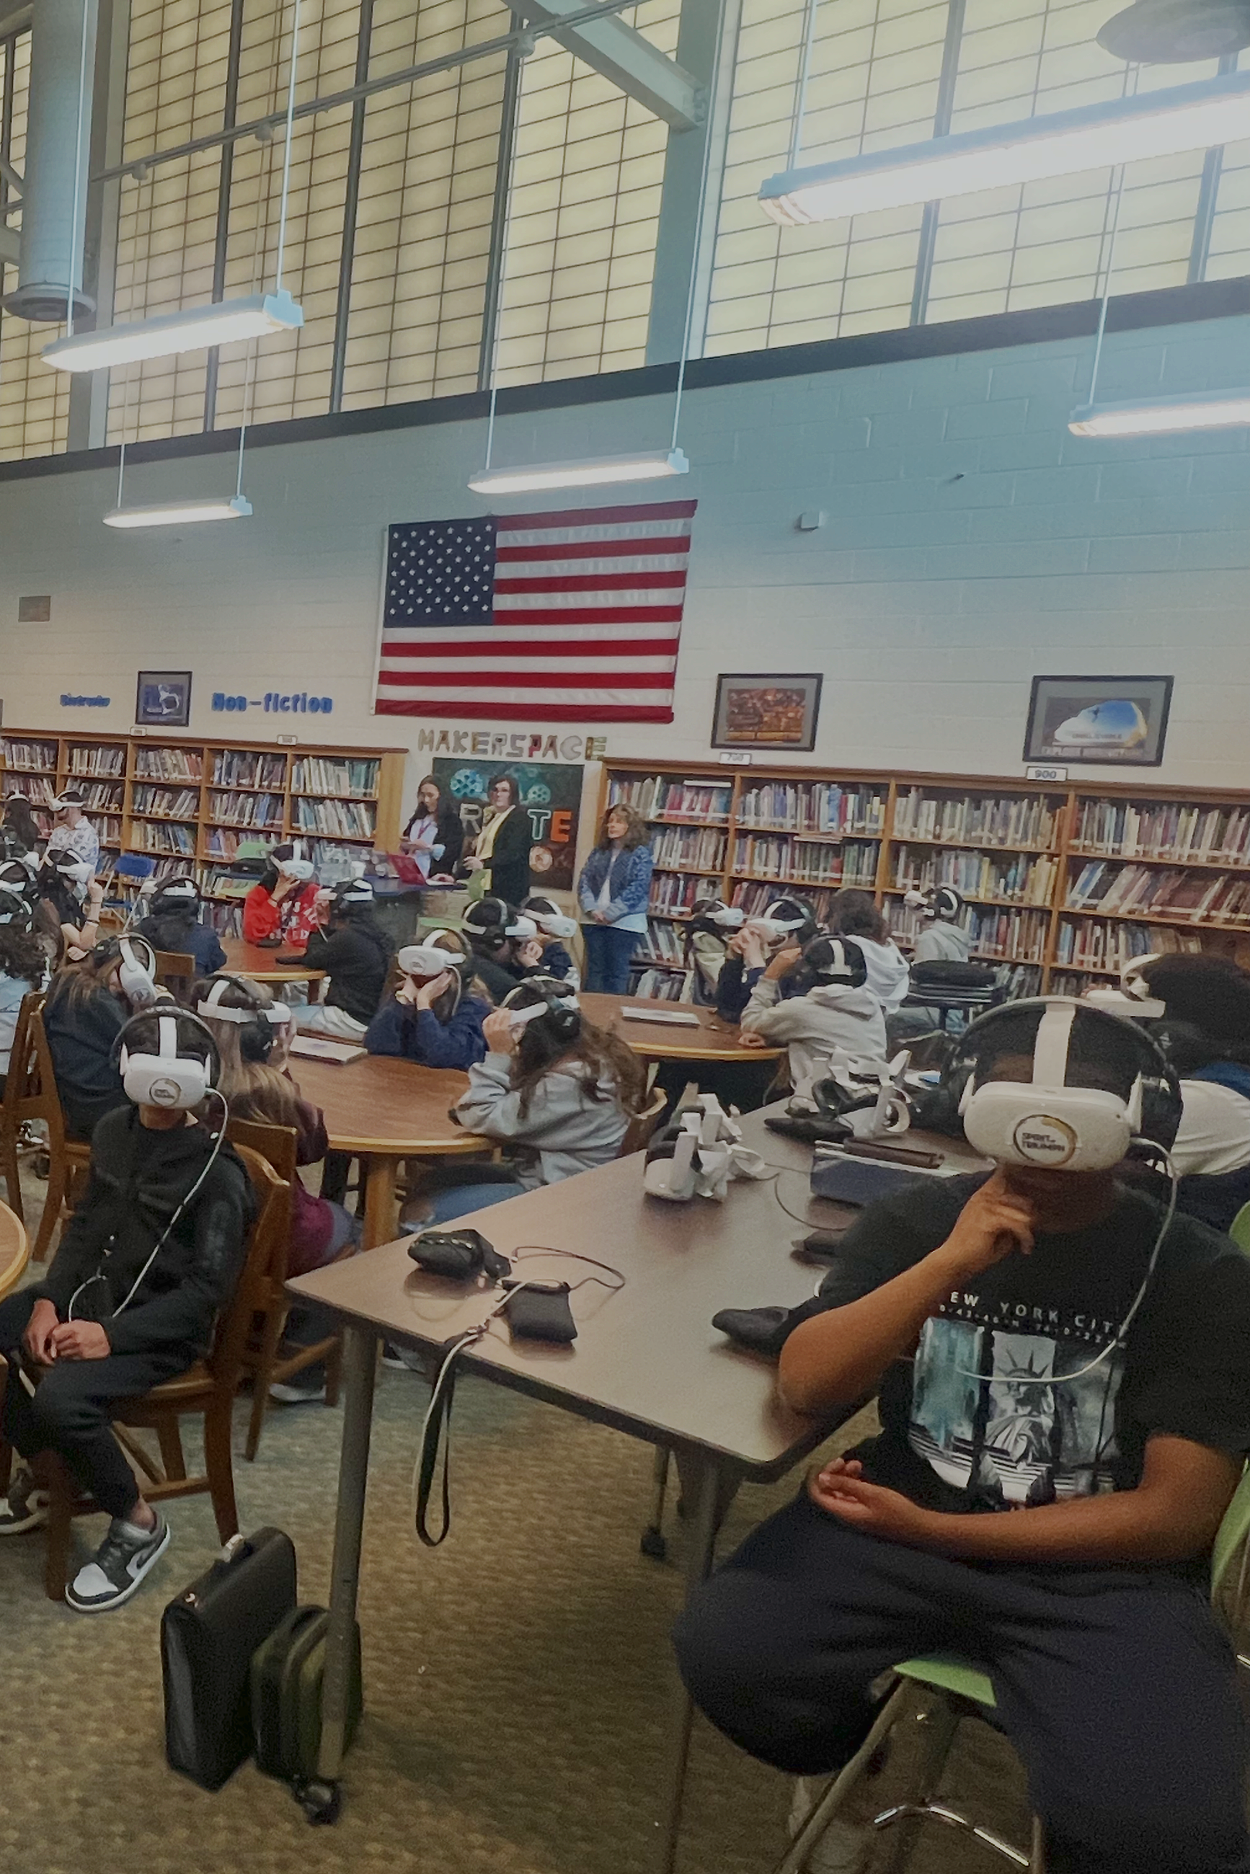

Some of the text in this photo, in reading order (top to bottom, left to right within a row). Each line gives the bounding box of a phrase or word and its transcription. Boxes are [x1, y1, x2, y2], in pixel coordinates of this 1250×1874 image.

[211, 692, 333, 714] Non-fiction
[417, 728, 607, 761] MAKERSPACE
[950, 1291, 980, 1307] EW
[1000, 1302, 1059, 1324] YORK
